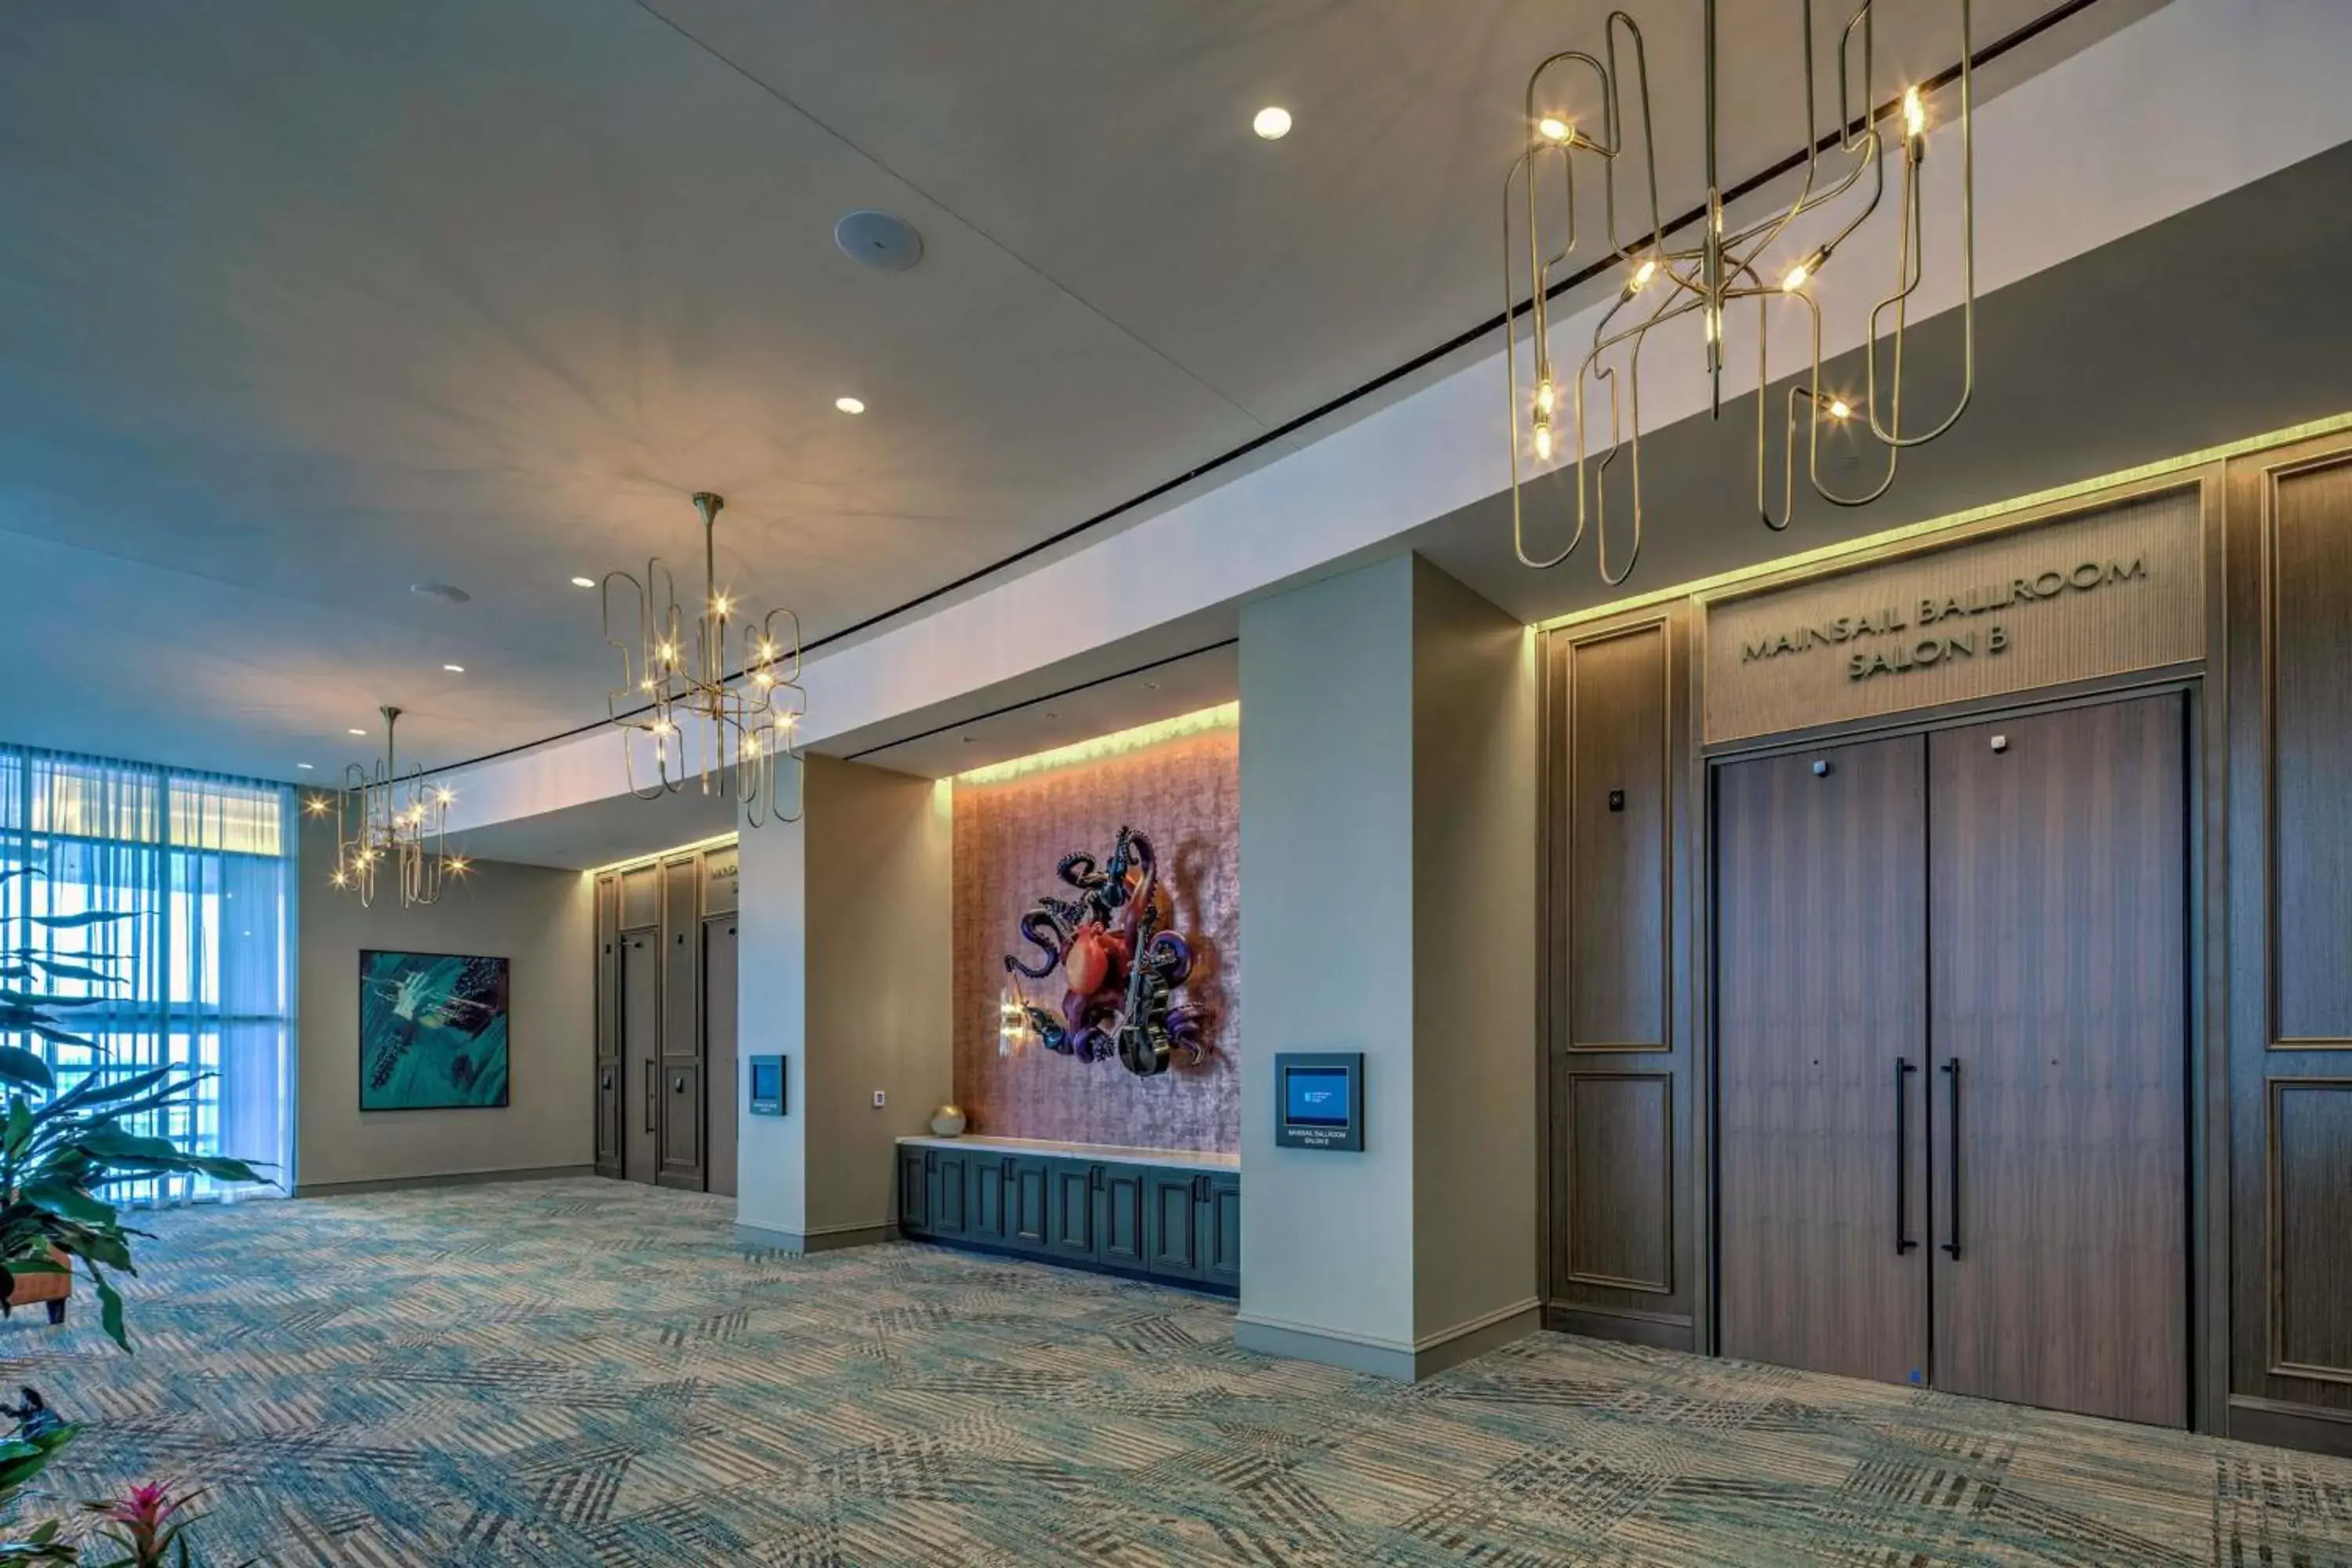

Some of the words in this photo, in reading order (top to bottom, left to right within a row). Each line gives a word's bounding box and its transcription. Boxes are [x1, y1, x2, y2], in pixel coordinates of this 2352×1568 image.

[1741, 608, 1907, 664] MAINSAIL
[1918, 551, 2147, 625] BALLROOM
[1849, 633, 1974, 681] SALON
[1988, 626, 2008, 654] B
